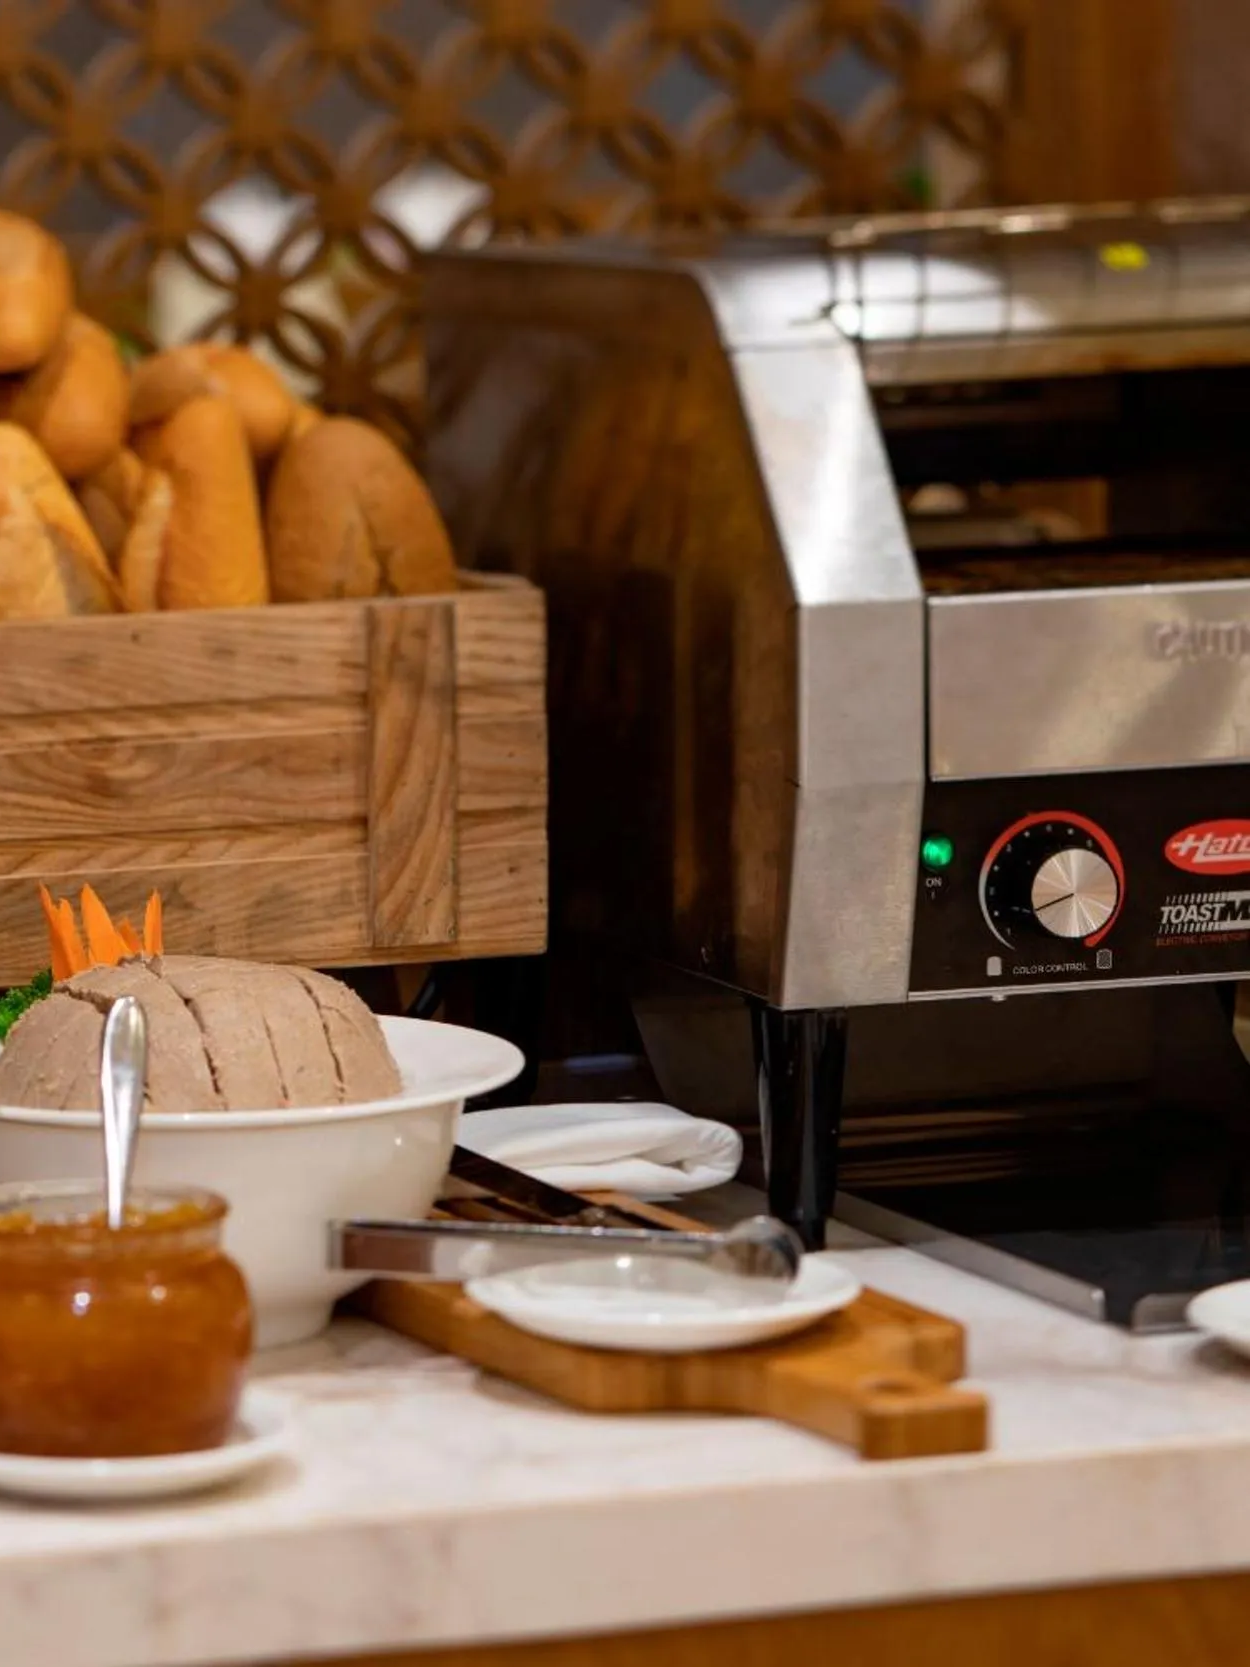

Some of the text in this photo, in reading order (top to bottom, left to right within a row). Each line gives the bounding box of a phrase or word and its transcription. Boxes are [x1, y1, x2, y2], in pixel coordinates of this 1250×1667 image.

[925, 876, 942, 888] ON
[1160, 903, 1226, 924] TOAST
[1012, 962, 1088, 975] COLOR CONTROL
